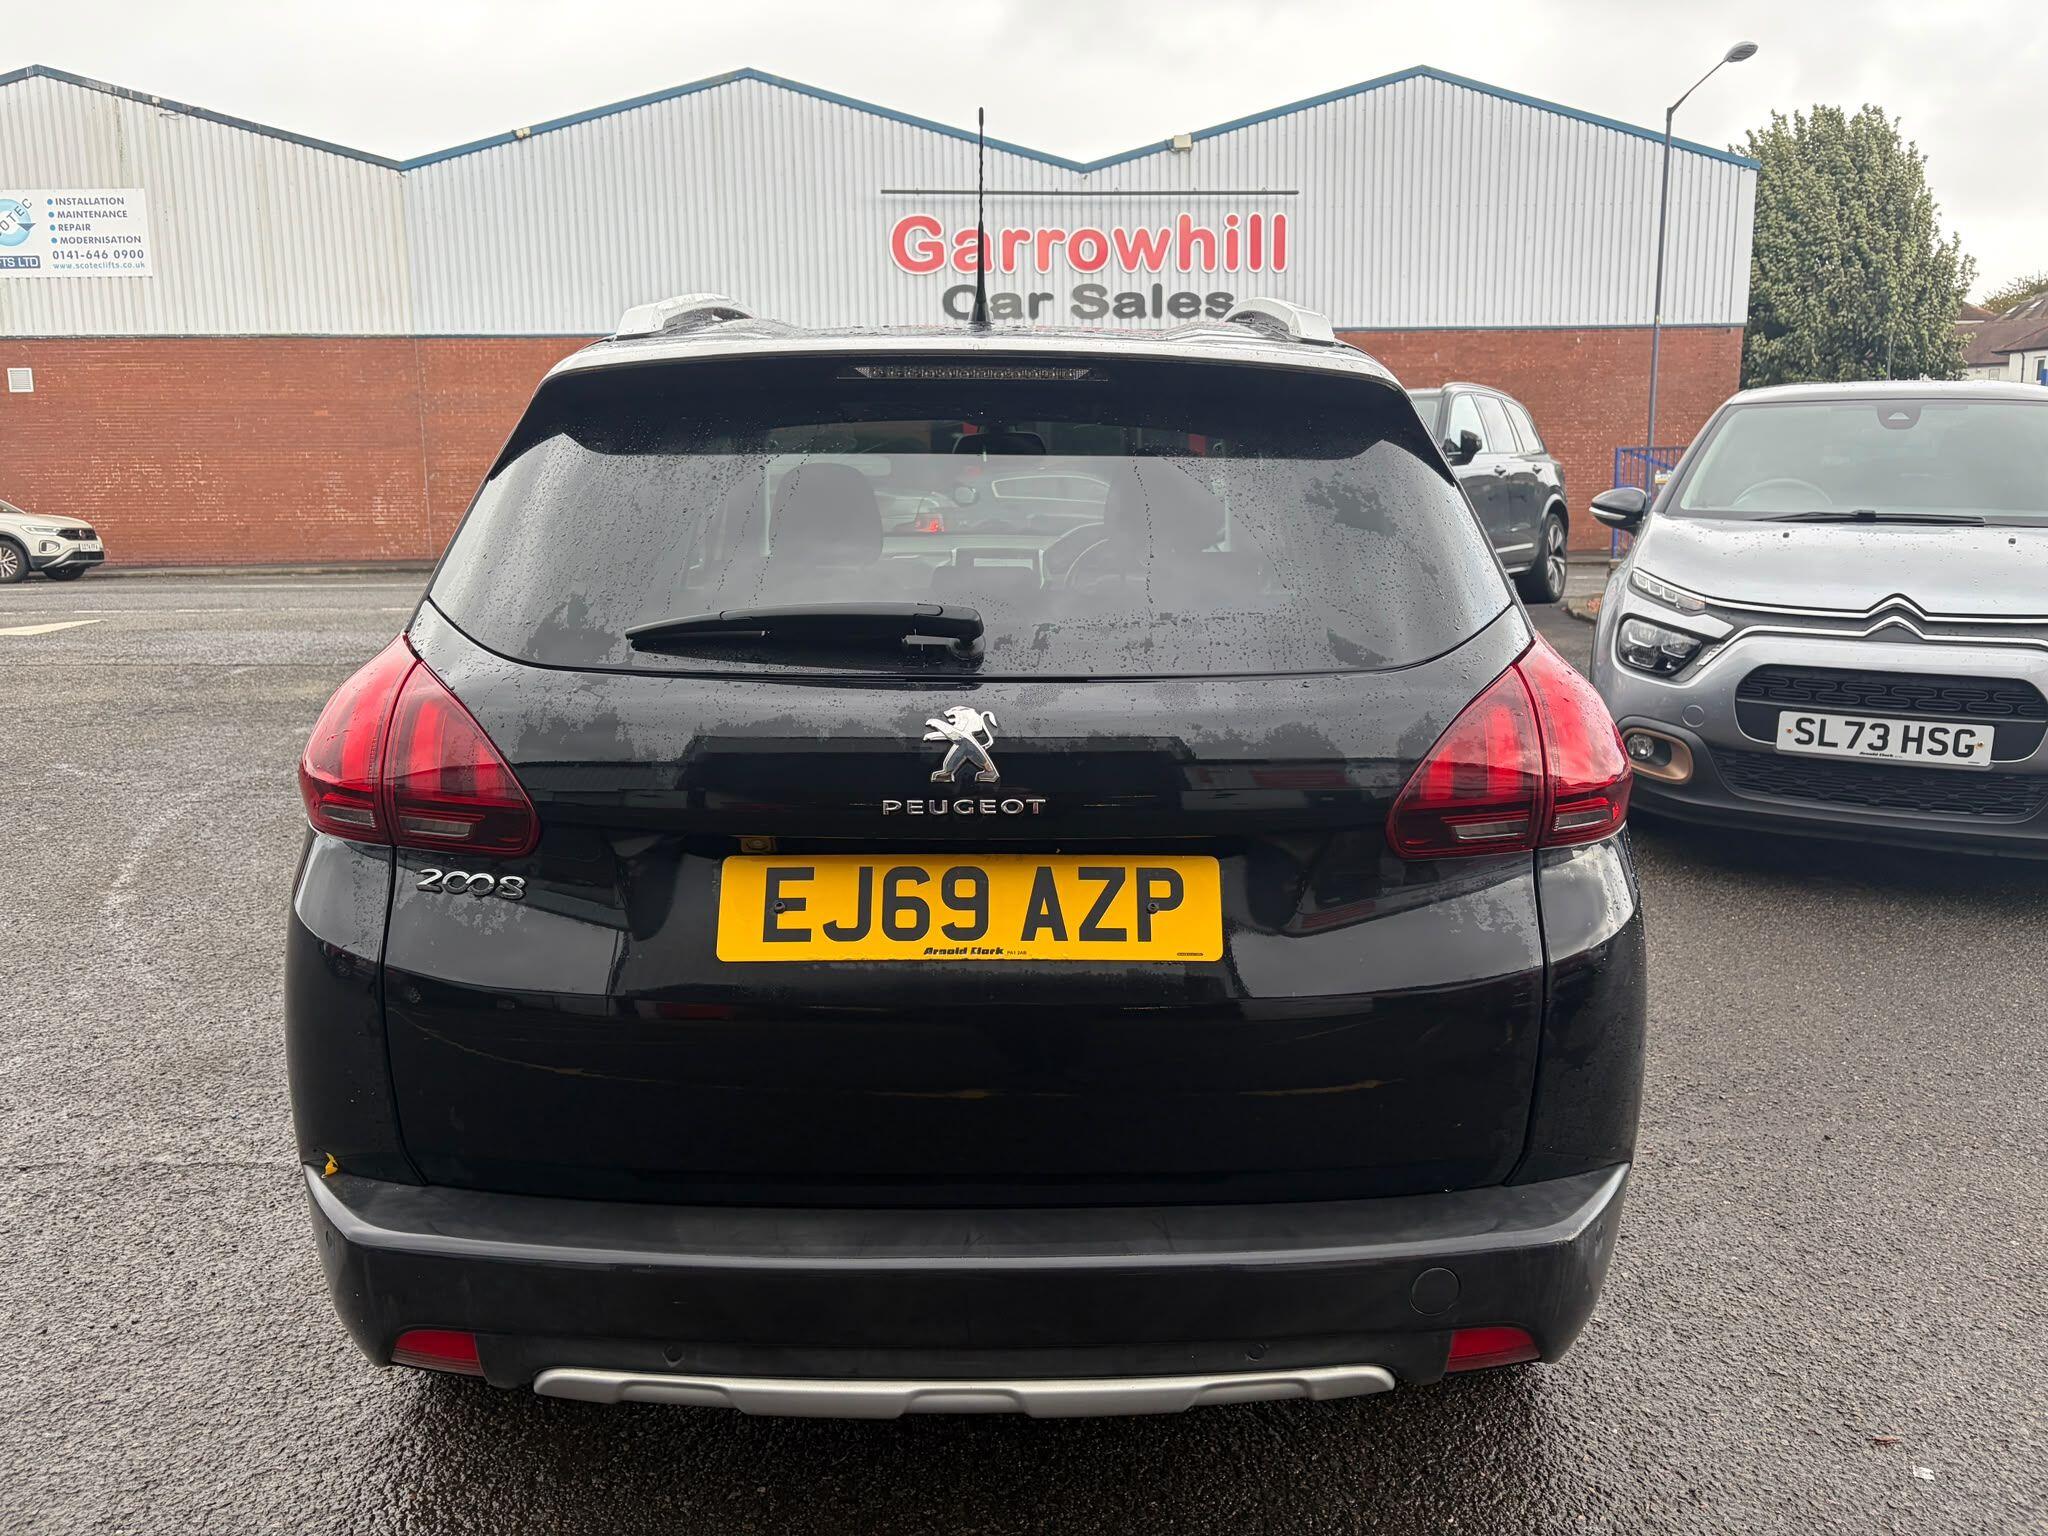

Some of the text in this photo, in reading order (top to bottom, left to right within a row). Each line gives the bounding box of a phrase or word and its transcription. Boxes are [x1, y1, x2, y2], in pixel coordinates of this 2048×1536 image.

[55, 197, 125, 206] INSTALLATION
[0, 198, 33, 232] OTEC
[57, 210, 128, 219] MAINTENANCE
[58, 223, 92, 232] REPAIR
[60, 235, 142, 245] MODERNISATION
[890, 211, 1289, 274] Garrowhill
[52, 249, 145, 260] 0141-646 0900
[0, 257, 39, 267] TS LTD
[942, 283, 1235, 320] Car Sales
[1794, 717, 1977, 758] SL73 HSG
[882, 799, 1047, 815] PEUGEOT
[416, 868, 526, 900] 2008
[762, 865, 1184, 943] EJ69 AZP
[923, 947, 968, 955] Arnold
[970, 947, 1004, 955] Clark
